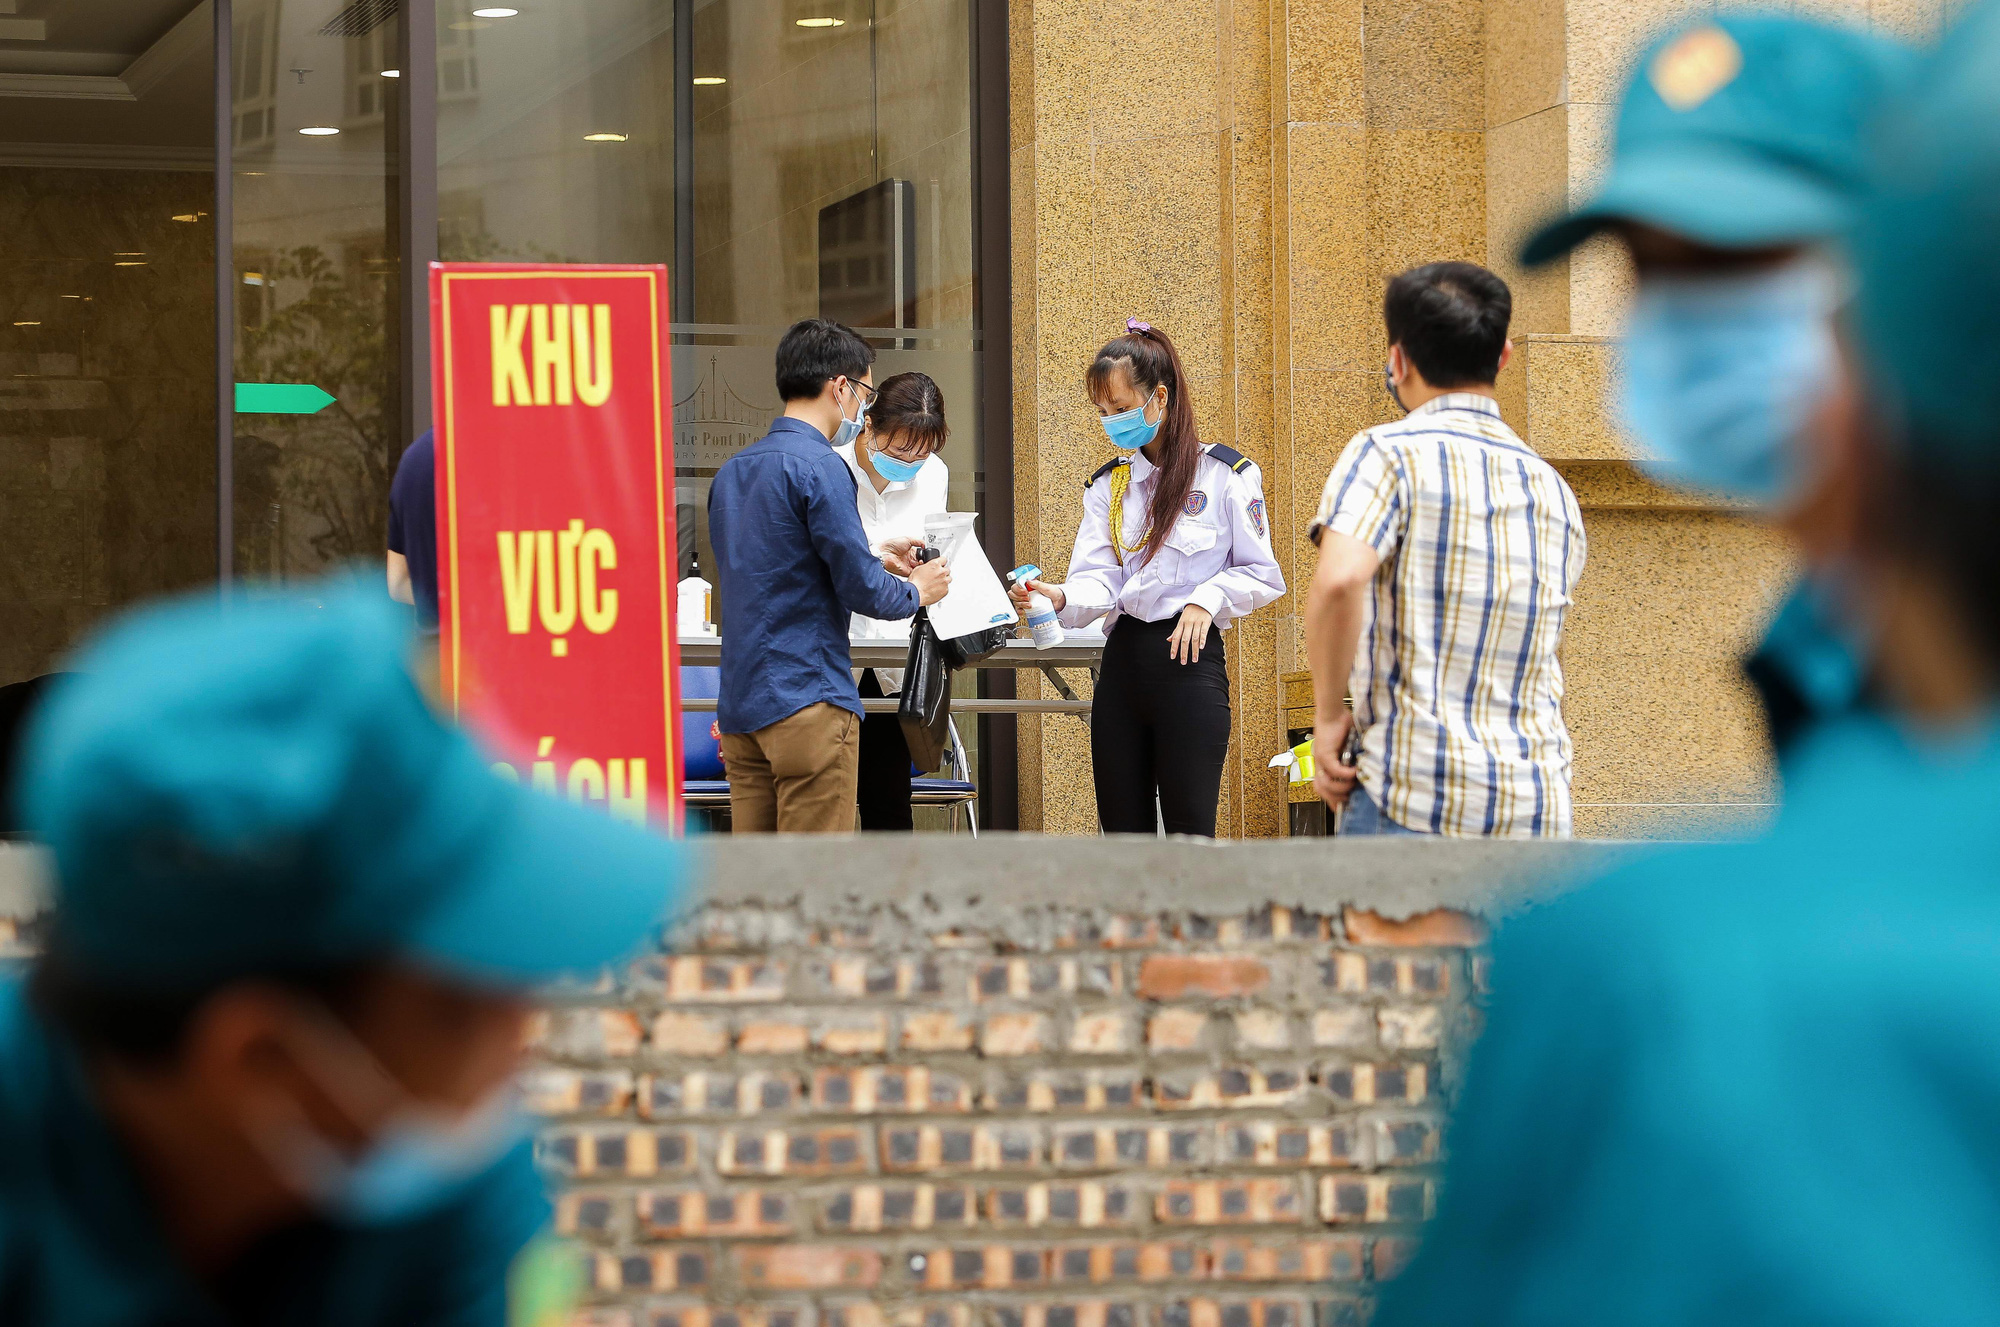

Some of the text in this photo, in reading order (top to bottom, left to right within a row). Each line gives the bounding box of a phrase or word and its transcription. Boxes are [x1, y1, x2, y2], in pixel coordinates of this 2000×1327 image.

[489, 303, 612, 407] KHU
[703, 431, 732, 446] Pont
[497, 518, 619, 657] VỰC
